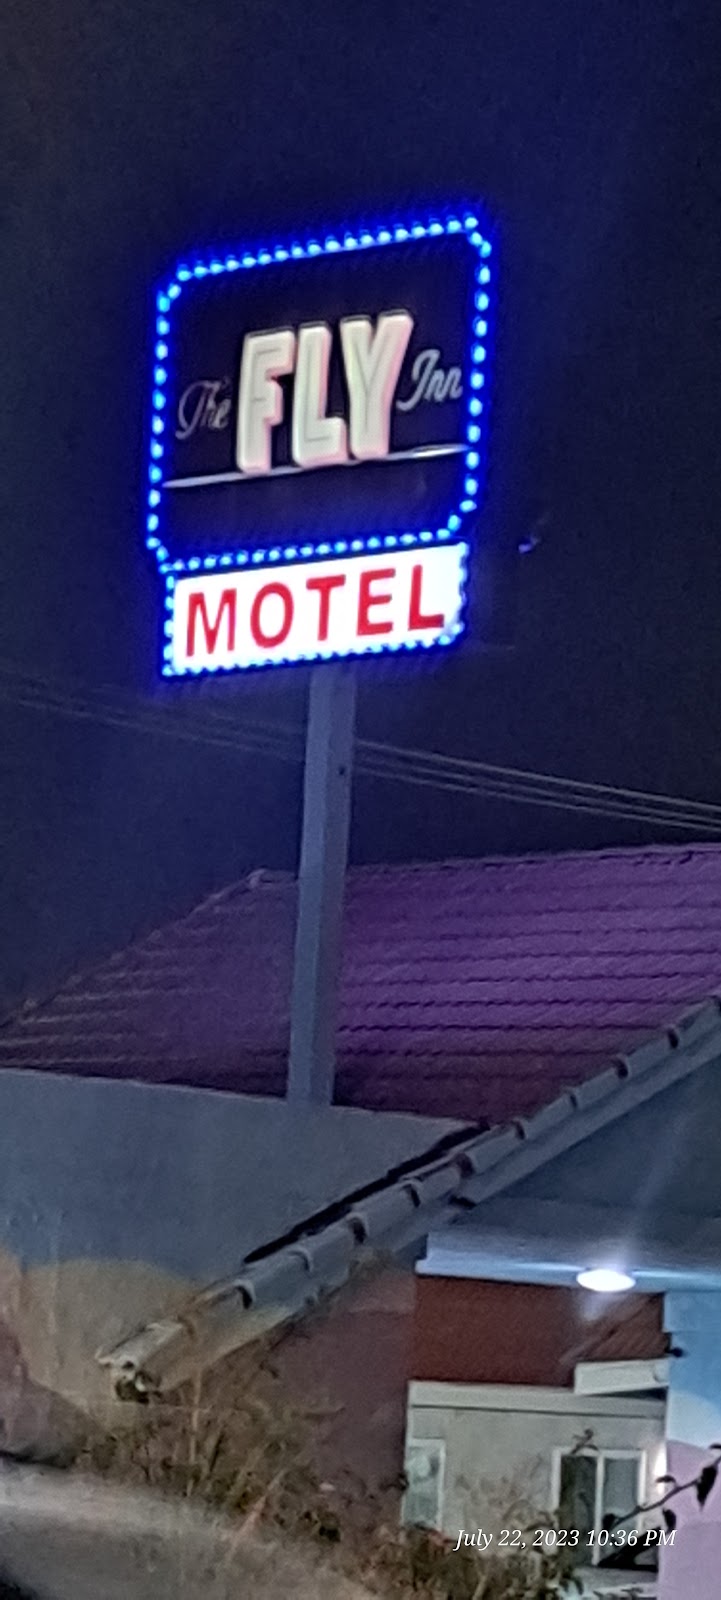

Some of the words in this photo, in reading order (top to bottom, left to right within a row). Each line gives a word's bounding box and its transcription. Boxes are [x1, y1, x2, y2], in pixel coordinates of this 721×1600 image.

[175, 378, 230, 439] The
[236, 309, 414, 476] FLY
[396, 349, 463, 411] Inn
[185, 564, 445, 658] MOTEL
